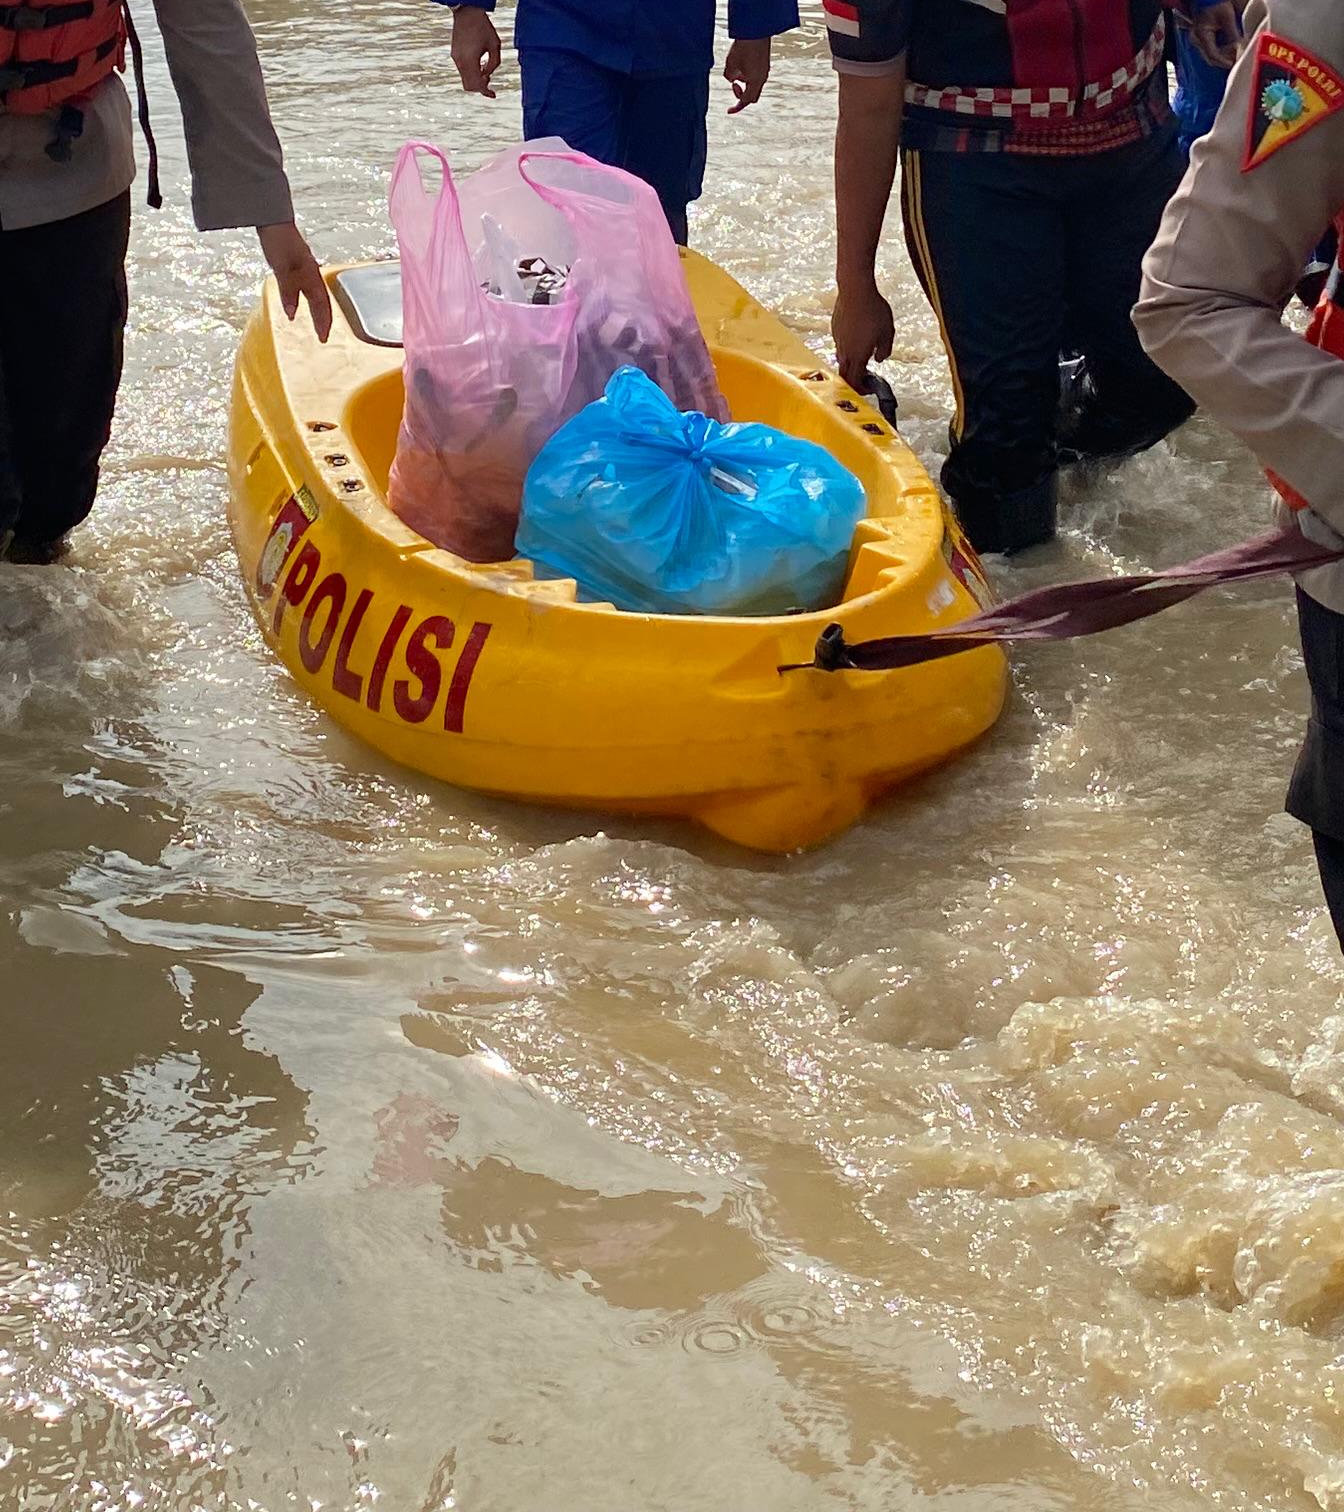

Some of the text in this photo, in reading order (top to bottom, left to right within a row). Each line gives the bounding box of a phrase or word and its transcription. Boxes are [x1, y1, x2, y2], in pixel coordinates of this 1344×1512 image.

[1268, 42, 1342, 98] OPS POLRI
[273, 540, 493, 734] POLISI
